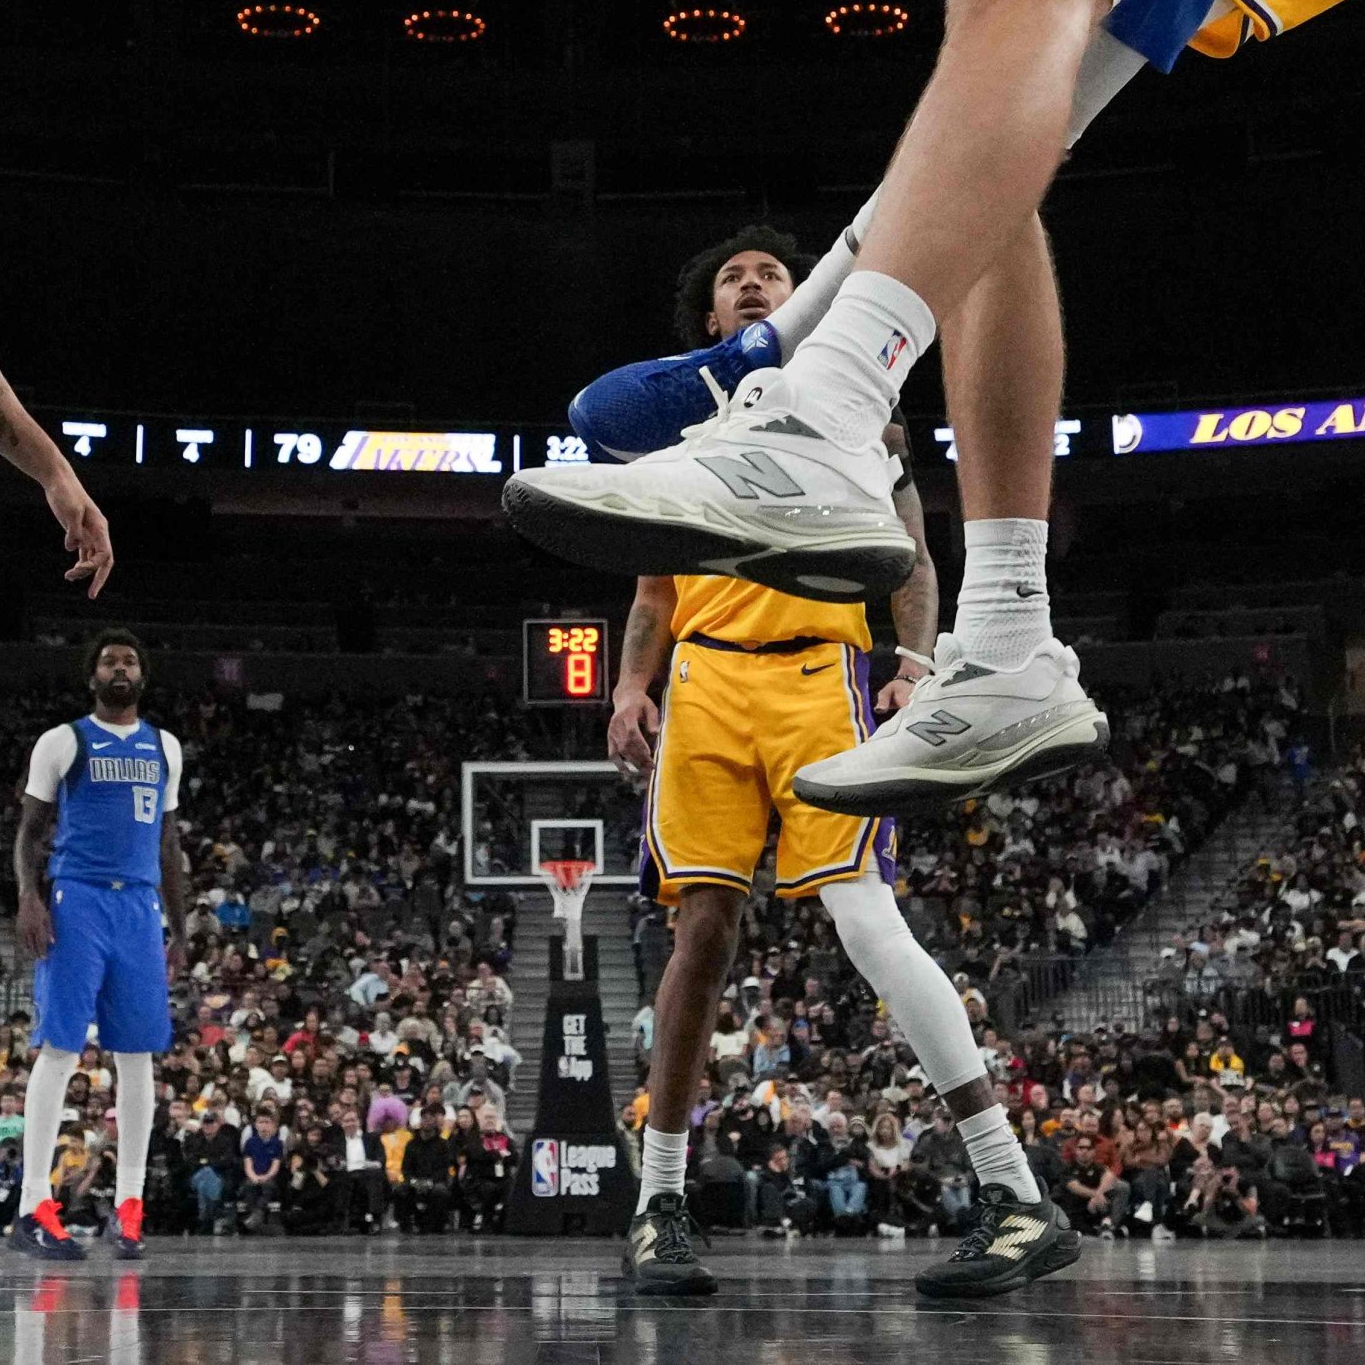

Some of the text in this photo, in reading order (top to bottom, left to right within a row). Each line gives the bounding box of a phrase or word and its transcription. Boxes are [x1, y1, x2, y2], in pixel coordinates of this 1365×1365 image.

[1189, 405, 1306, 445] LOS
[273, 433, 322, 465] 79
[546, 435, 589, 461] 3:22
[548, 627, 599, 653] 3:22
[567, 653, 592, 696] 8
[89, 757, 161, 784] DALLAS
[133, 786, 158, 824] 13
[562, 1013, 587, 1035] GET
[563, 1035, 587, 1056] THE
[560, 1140, 617, 1174] League
[560, 1168, 600, 1197] Pass
